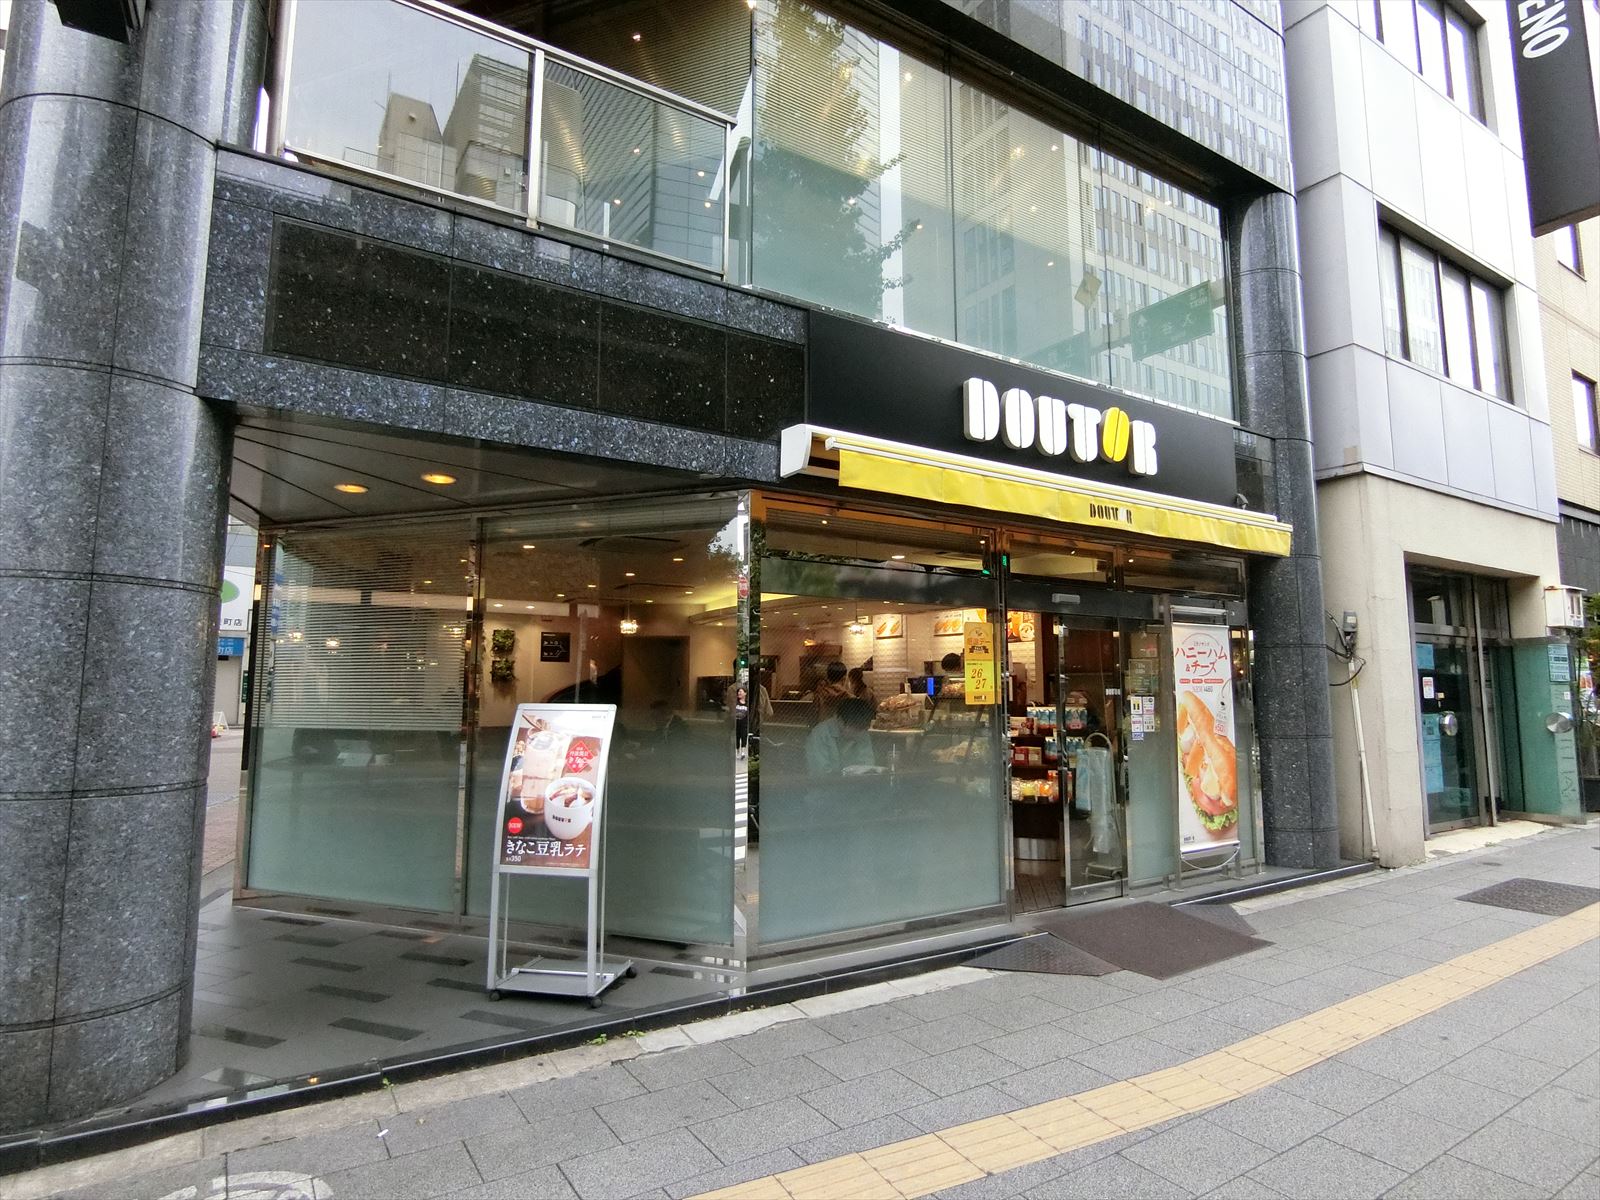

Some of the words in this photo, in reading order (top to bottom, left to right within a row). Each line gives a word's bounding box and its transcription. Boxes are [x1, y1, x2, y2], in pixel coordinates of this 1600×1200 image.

[963, 377, 1158, 476] DOUTOR
[1089, 503, 1132, 524] DOUTOR
[1175, 645, 1228, 660] ハニーハム
[971, 668, 983, 679] 26
[1185, 660, 1217, 674] &チーズ
[975, 678, 987, 690] 27
[506, 839, 586, 857] きなこ豆乳ラテ
